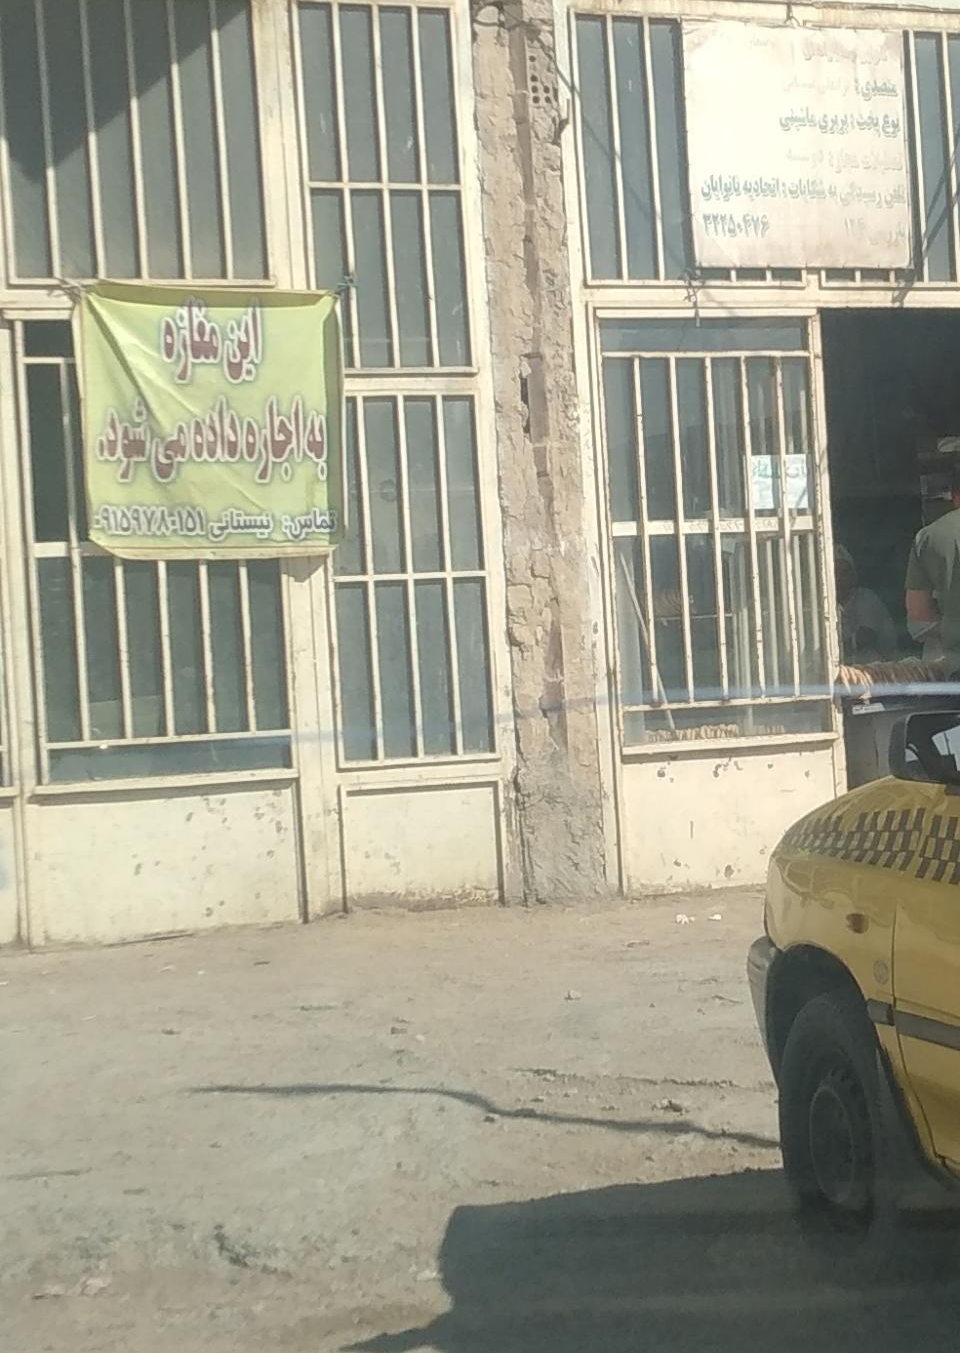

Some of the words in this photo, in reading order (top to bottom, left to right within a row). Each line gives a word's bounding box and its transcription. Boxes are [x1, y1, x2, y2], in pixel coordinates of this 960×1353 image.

[701, 175, 742, 202] نانوایان
[742, 177, 780, 202] اتحادیه
[162, 295, 221, 383] مغازه
[224, 296, 262, 383] این
[152, 422, 188, 482] می
[193, 396, 241, 462] داده
[243, 397, 302, 483] اجاره
[305, 410, 328, 481] به
[283, 508, 337, 541] تماس:
